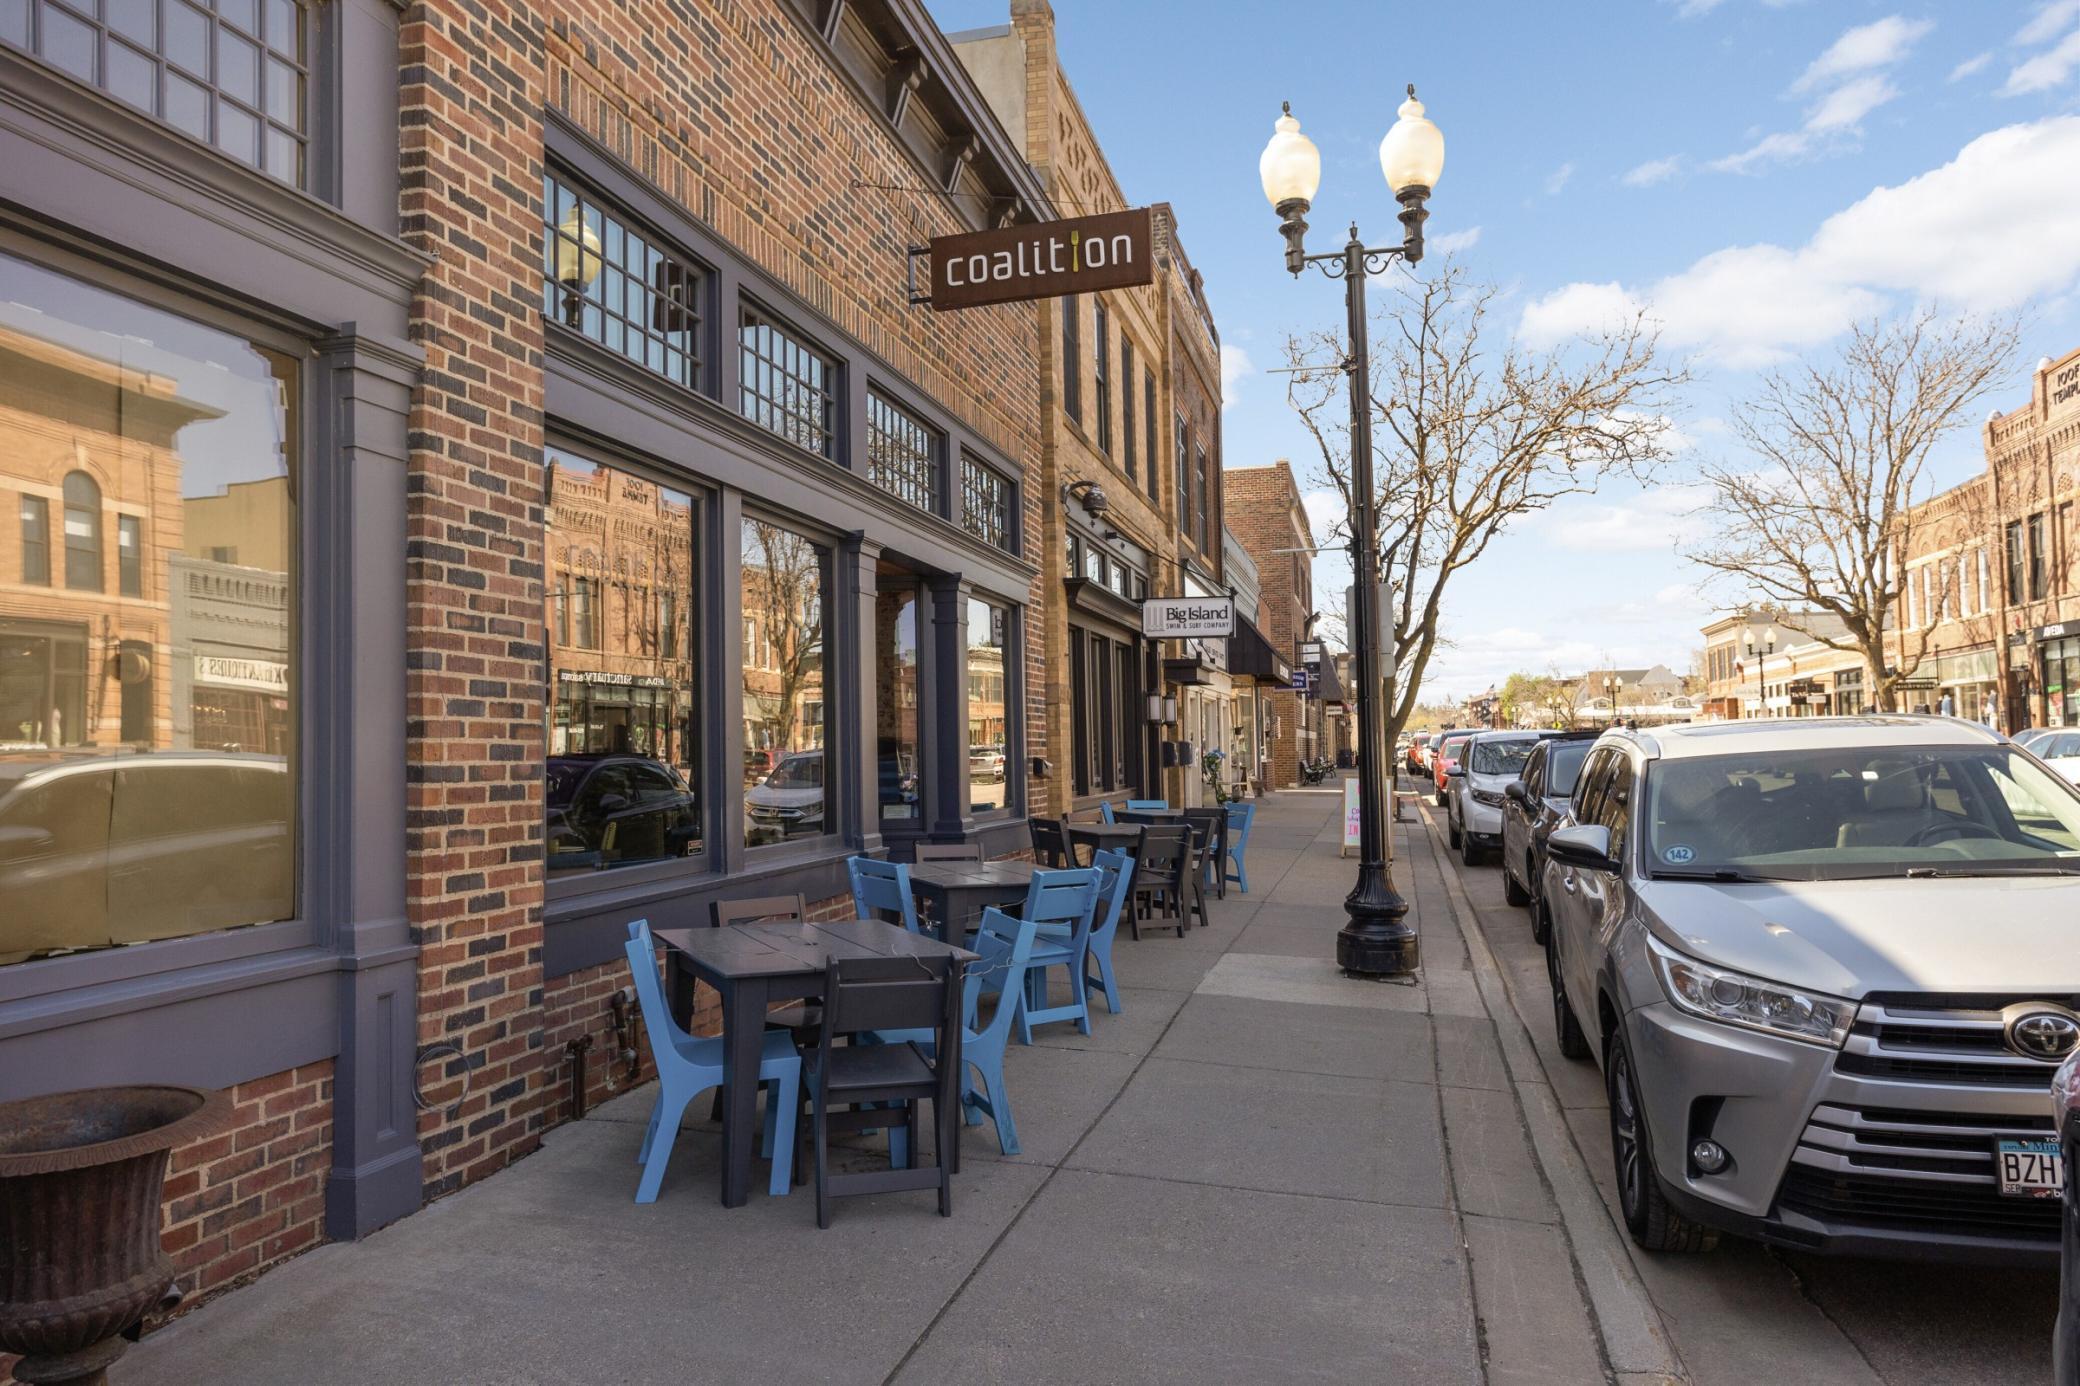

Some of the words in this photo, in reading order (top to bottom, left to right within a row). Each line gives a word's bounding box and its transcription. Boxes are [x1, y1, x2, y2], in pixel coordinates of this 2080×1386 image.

[946, 230, 1132, 287] coalition
[1166, 607, 1187, 623] Big
[1188, 605, 1228, 620] Island
[1670, 849, 1689, 860] 142
[2003, 1153, 2056, 1185] BZH
[2005, 1184, 2021, 1193] SEP
